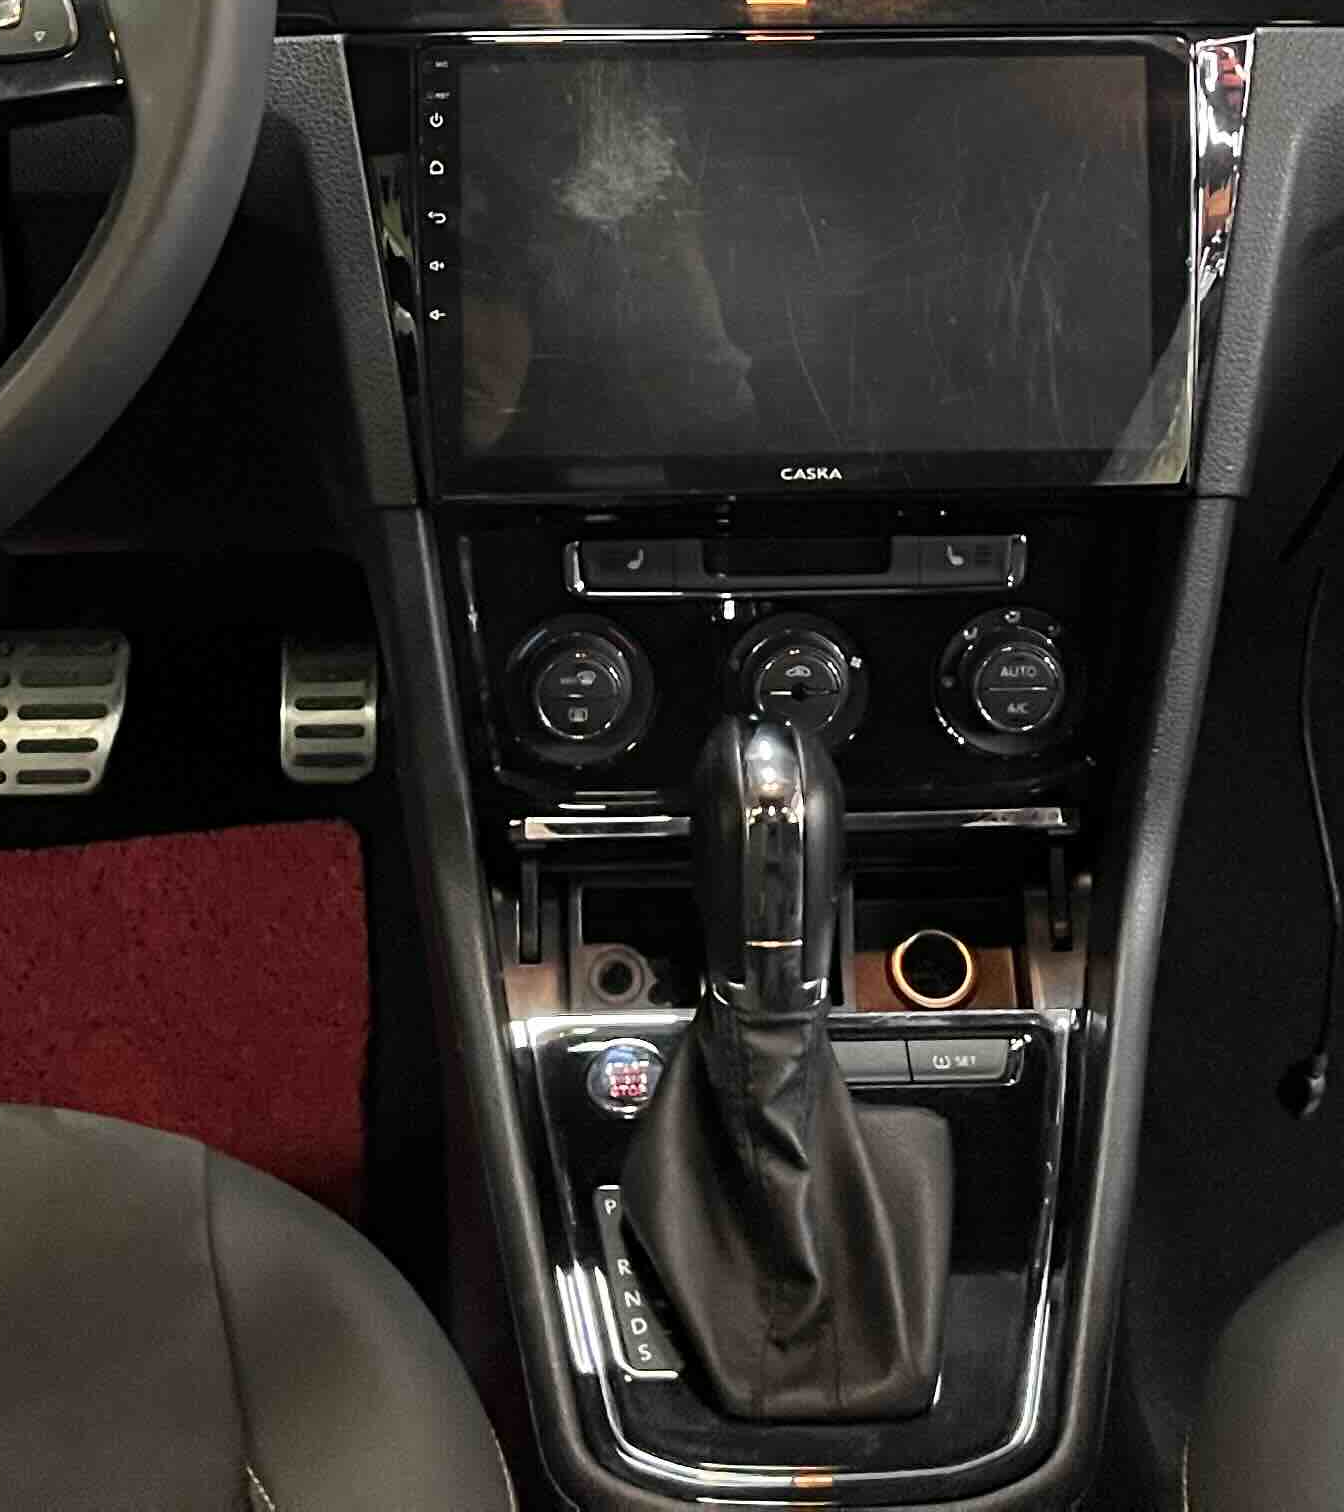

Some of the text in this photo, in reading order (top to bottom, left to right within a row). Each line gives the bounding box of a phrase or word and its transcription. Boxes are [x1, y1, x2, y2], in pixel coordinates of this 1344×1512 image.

[780, 467, 843, 481] CASKA
[1000, 665, 1038, 678] AUTO
[604, 1199, 617, 1216] P
[617, 1258, 633, 1276] R
[624, 1290, 642, 1308] N
[630, 1317, 648, 1335] D
[637, 1344, 653, 1362] S
